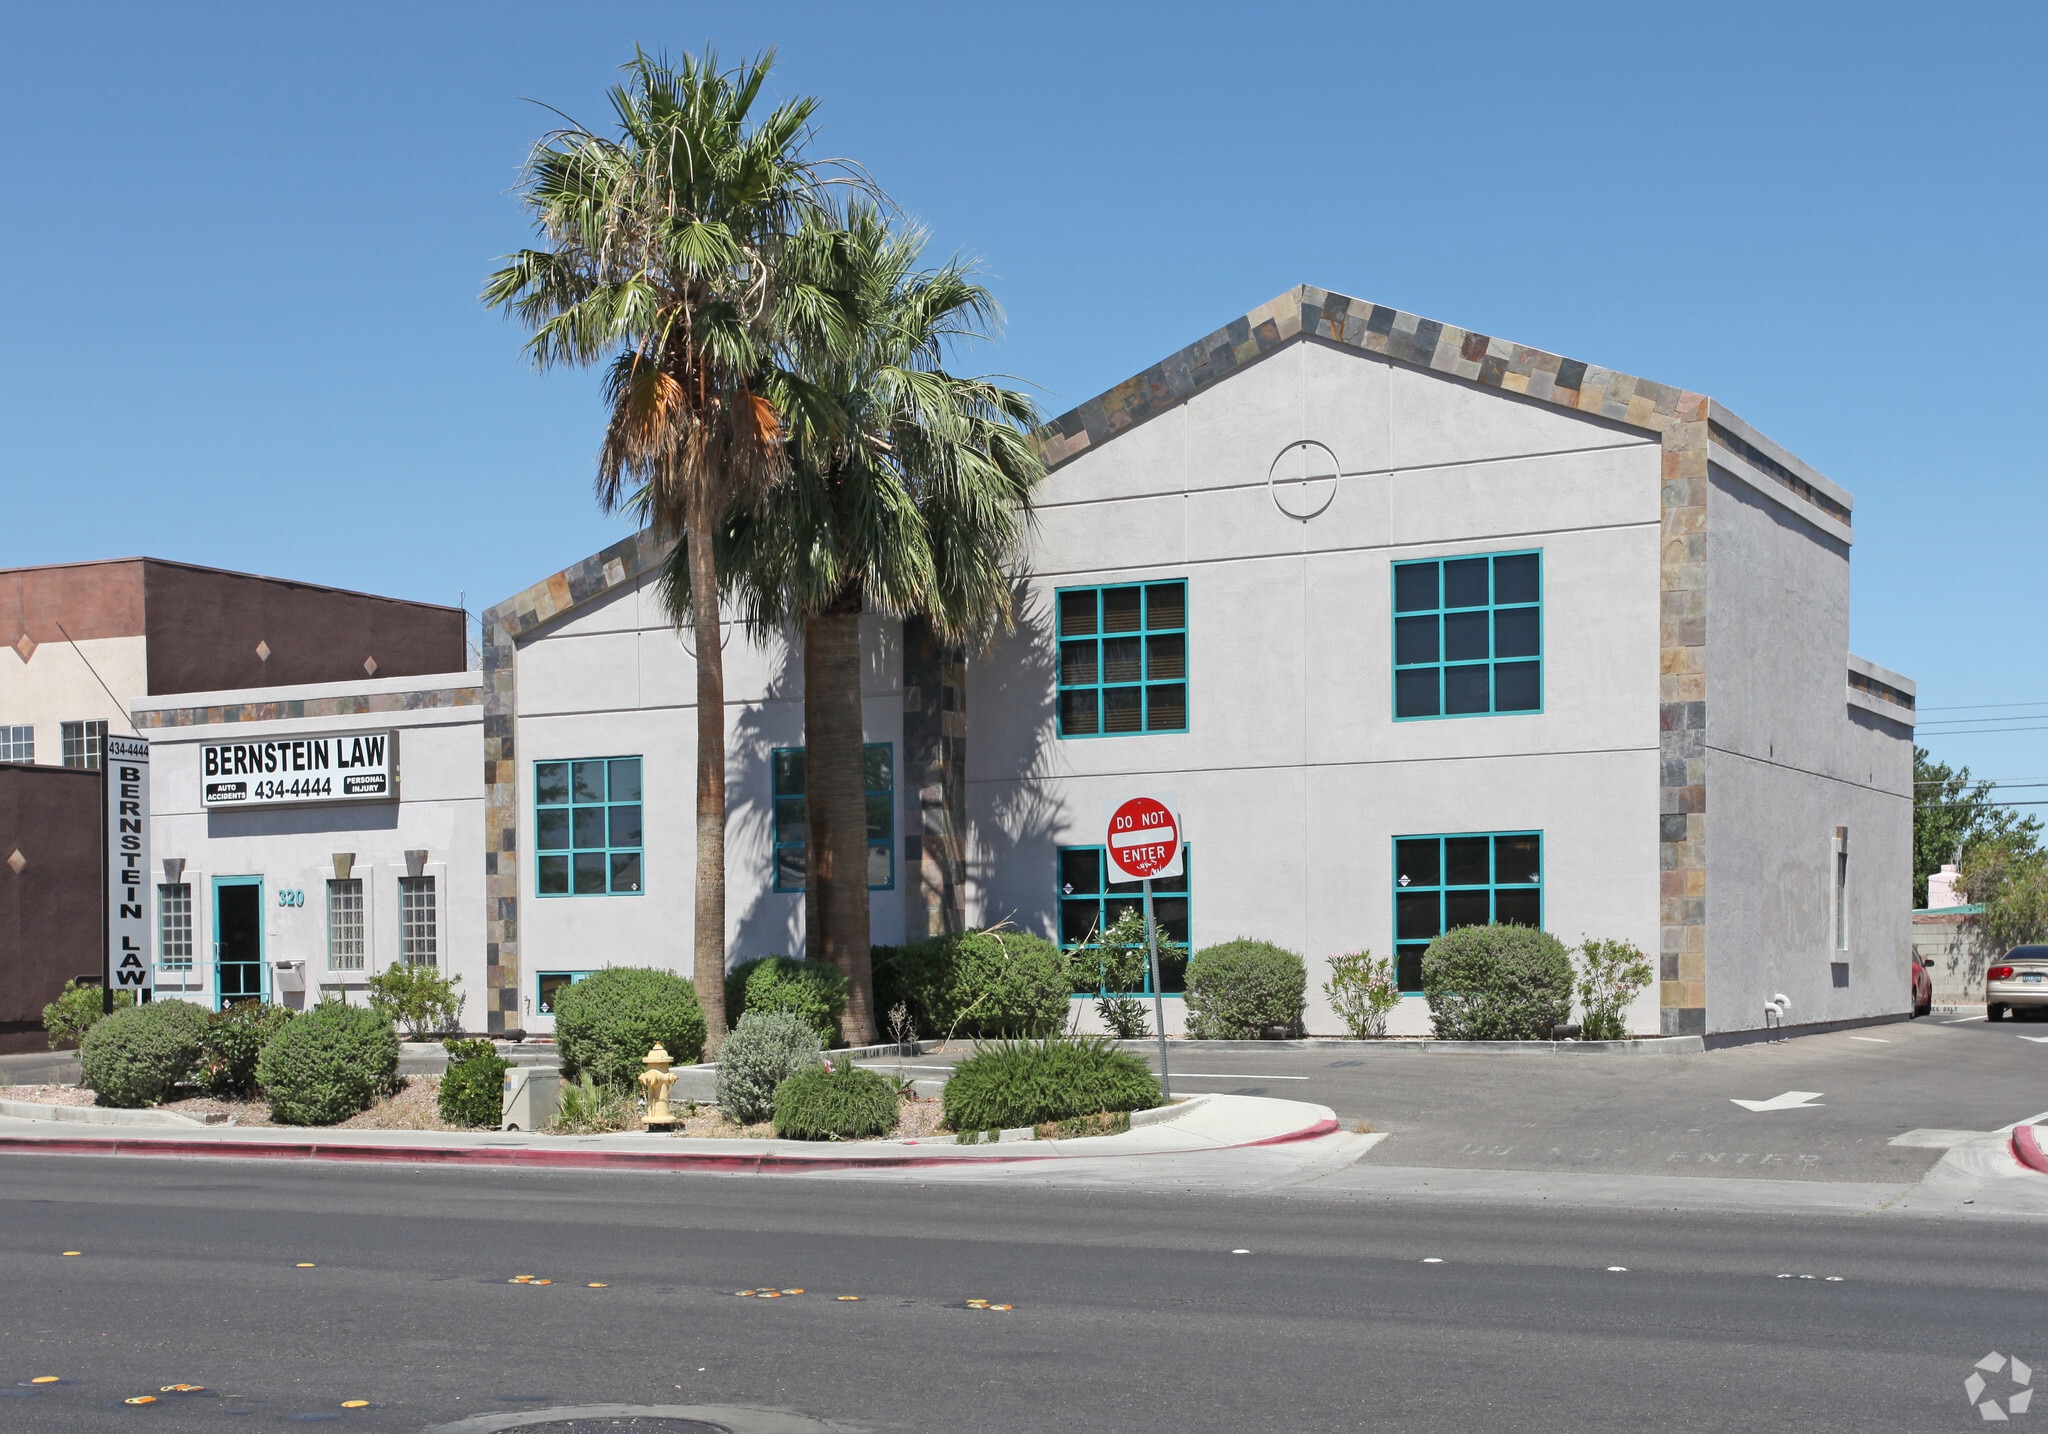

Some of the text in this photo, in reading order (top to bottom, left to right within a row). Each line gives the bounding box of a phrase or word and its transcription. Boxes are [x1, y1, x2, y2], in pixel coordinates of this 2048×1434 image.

[109, 741, 150, 758] 434-4444
[205, 735, 385, 777] BERNSTEIN LAW
[217, 784, 237, 792] AUTO
[255, 776, 332, 800] 434-4444
[346, 775, 385, 785] PERSONAL
[352, 784, 379, 793] INJURY
[207, 792, 247, 801] ACCIDENTS
[1116, 810, 1165, 830] DO NOT
[1123, 845, 1166, 863] ENTER
[115, 766, 146, 985] BERNSTEIN LAW
[278, 889, 305, 908] 320
